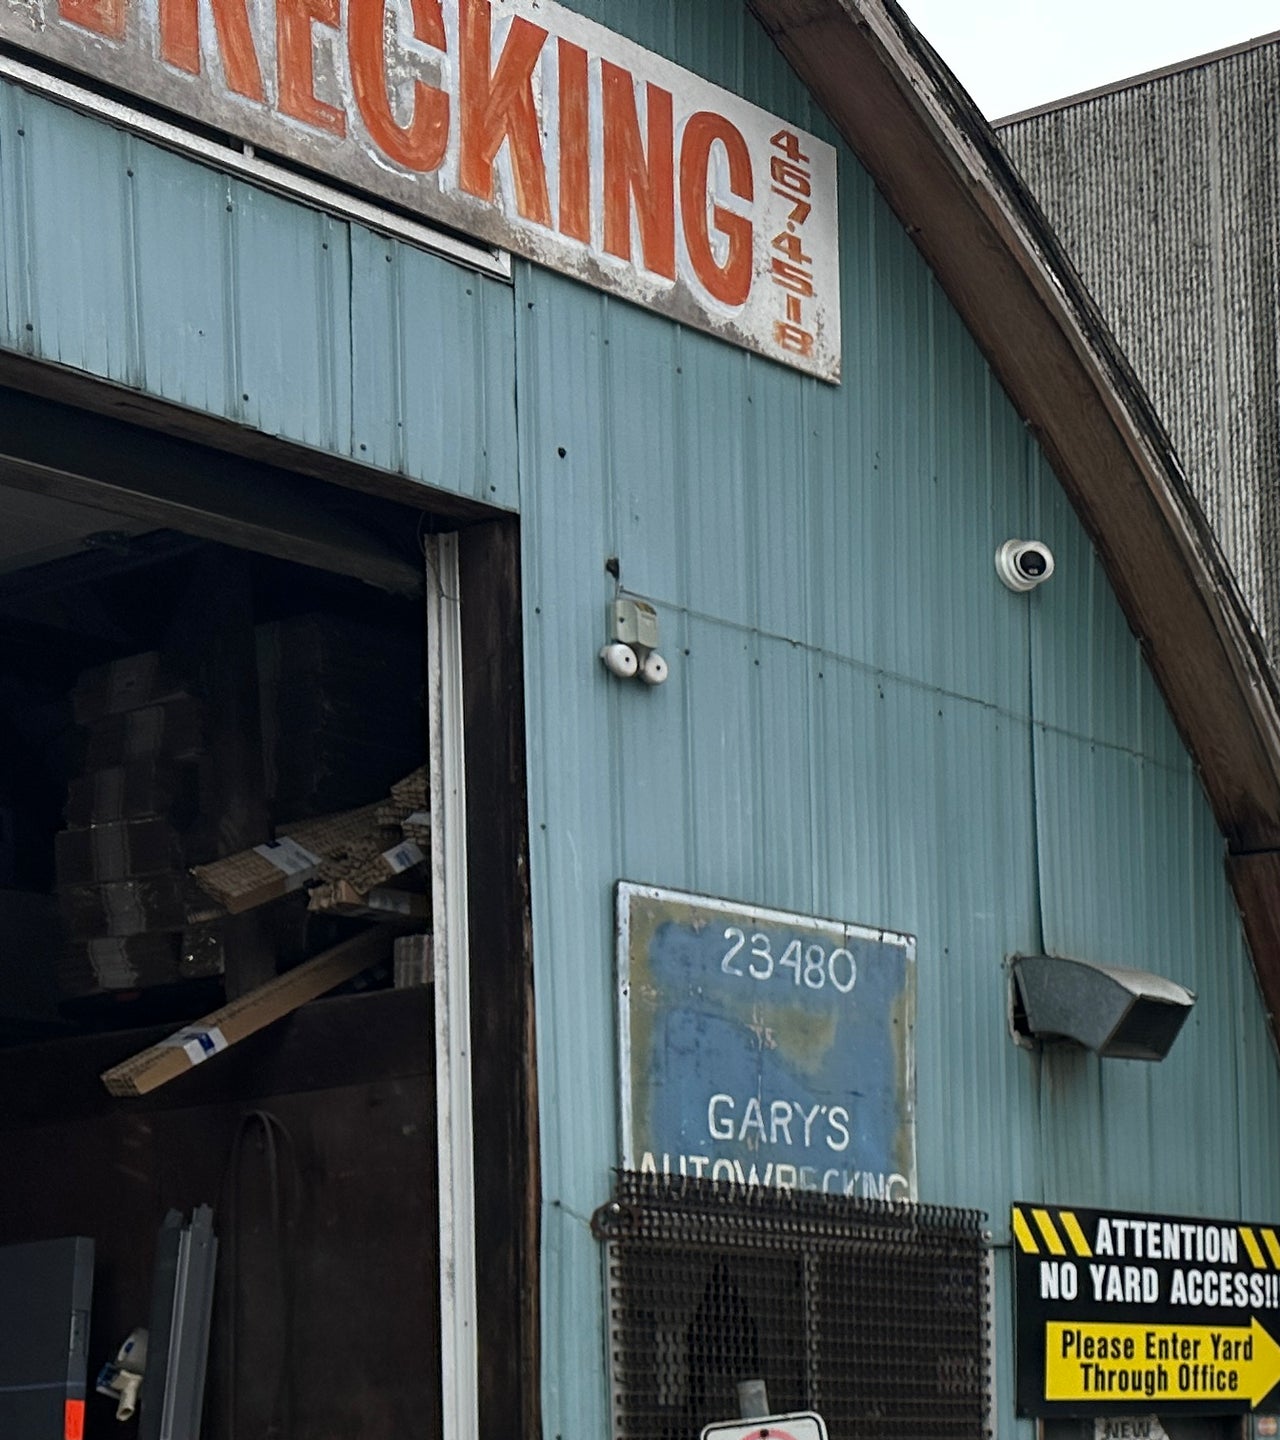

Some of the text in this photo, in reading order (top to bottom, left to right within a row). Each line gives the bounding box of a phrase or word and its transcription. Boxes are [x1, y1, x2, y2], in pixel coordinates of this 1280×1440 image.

[720, 927, 857, 993] 23480
[708, 1093, 850, 1152] GARY'S
[1095, 1217, 1238, 1264] ATTENTION
[1040, 1261, 1078, 1301] NO
[1089, 1263, 1159, 1303] YARD
[1062, 1330, 1253, 1361] Please Enter Yard
[1080, 1363, 1239, 1396] Through Office
[1105, 1420, 1151, 1439] NEW
